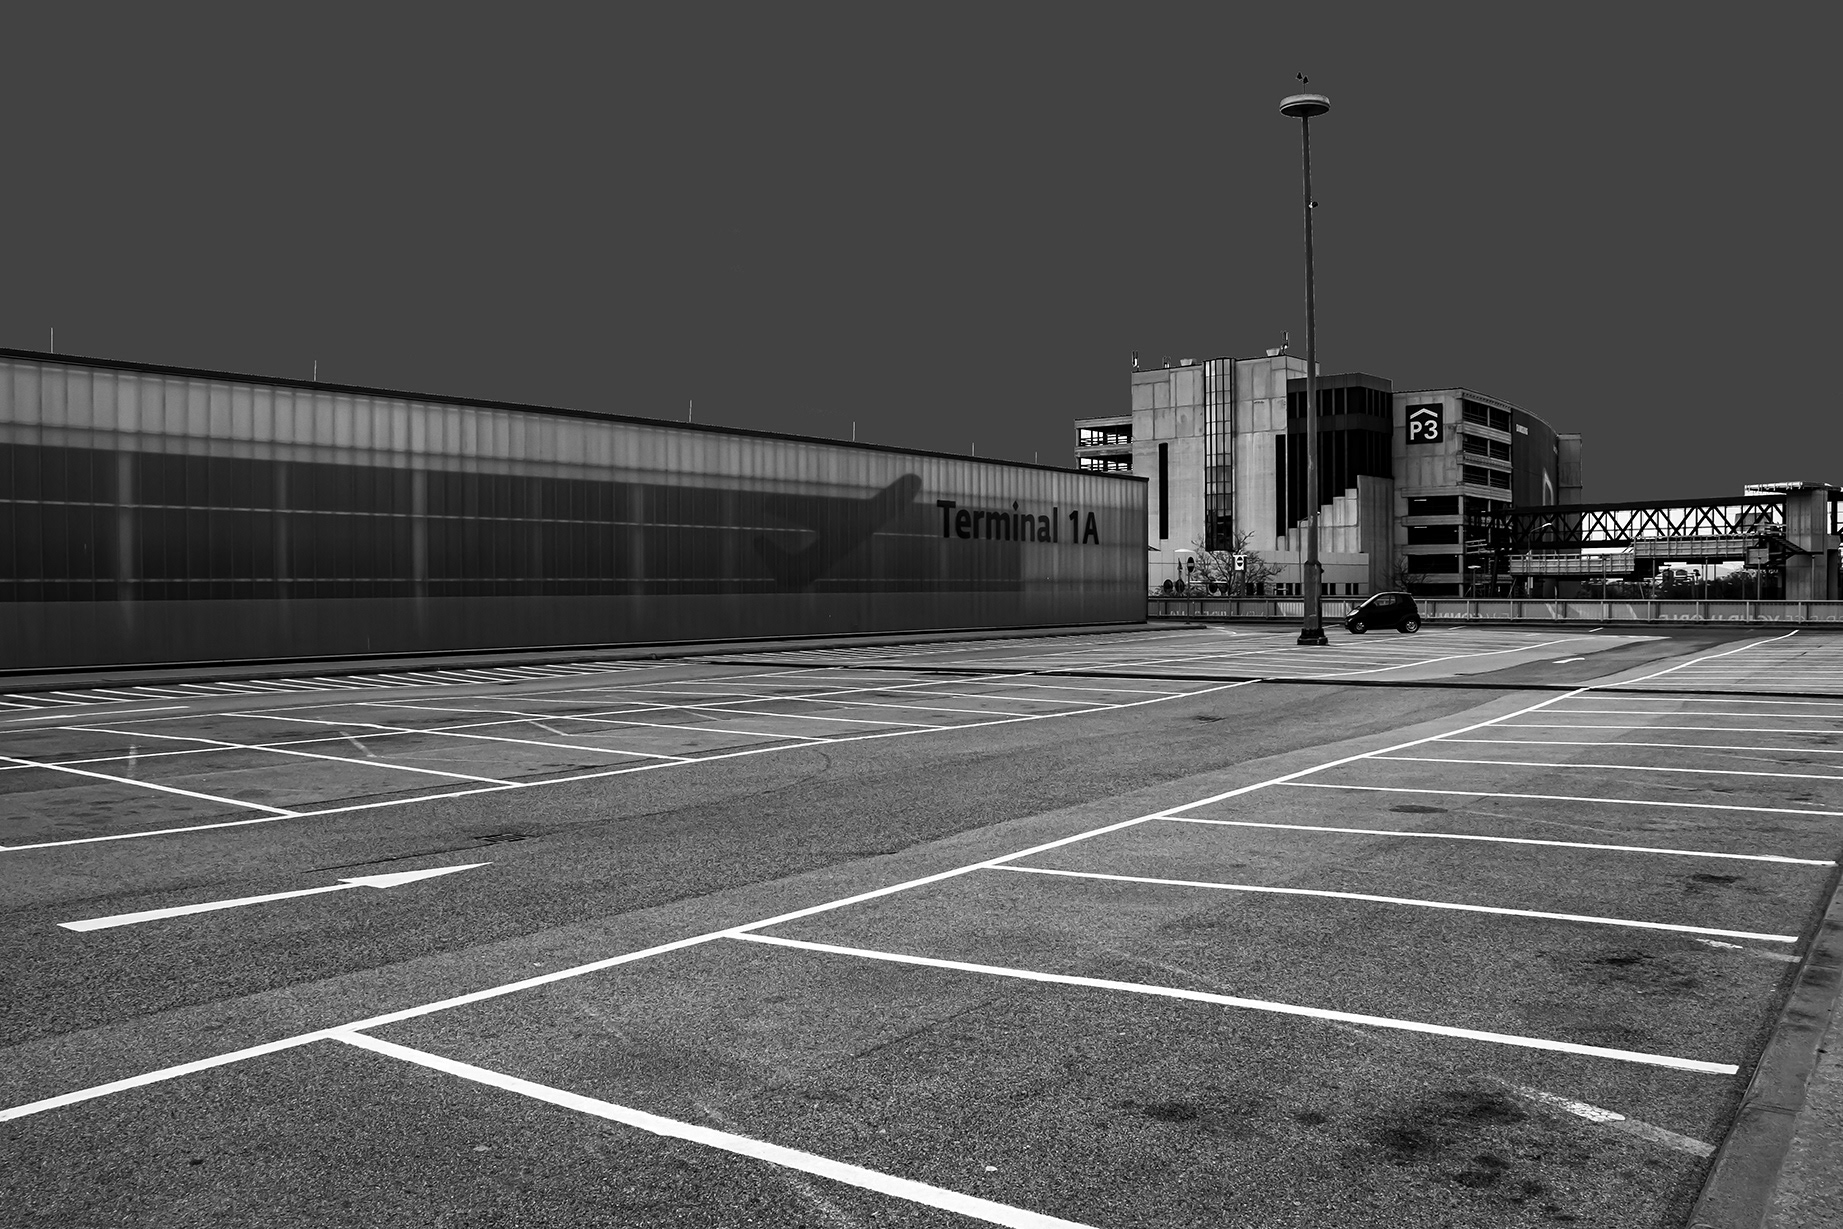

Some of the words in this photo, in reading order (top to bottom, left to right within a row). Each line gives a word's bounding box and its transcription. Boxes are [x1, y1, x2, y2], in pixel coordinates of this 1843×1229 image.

[1410, 420, 1438, 440] P3
[937, 500, 1058, 543] Terminal
[1069, 510, 1099, 545] 1A
